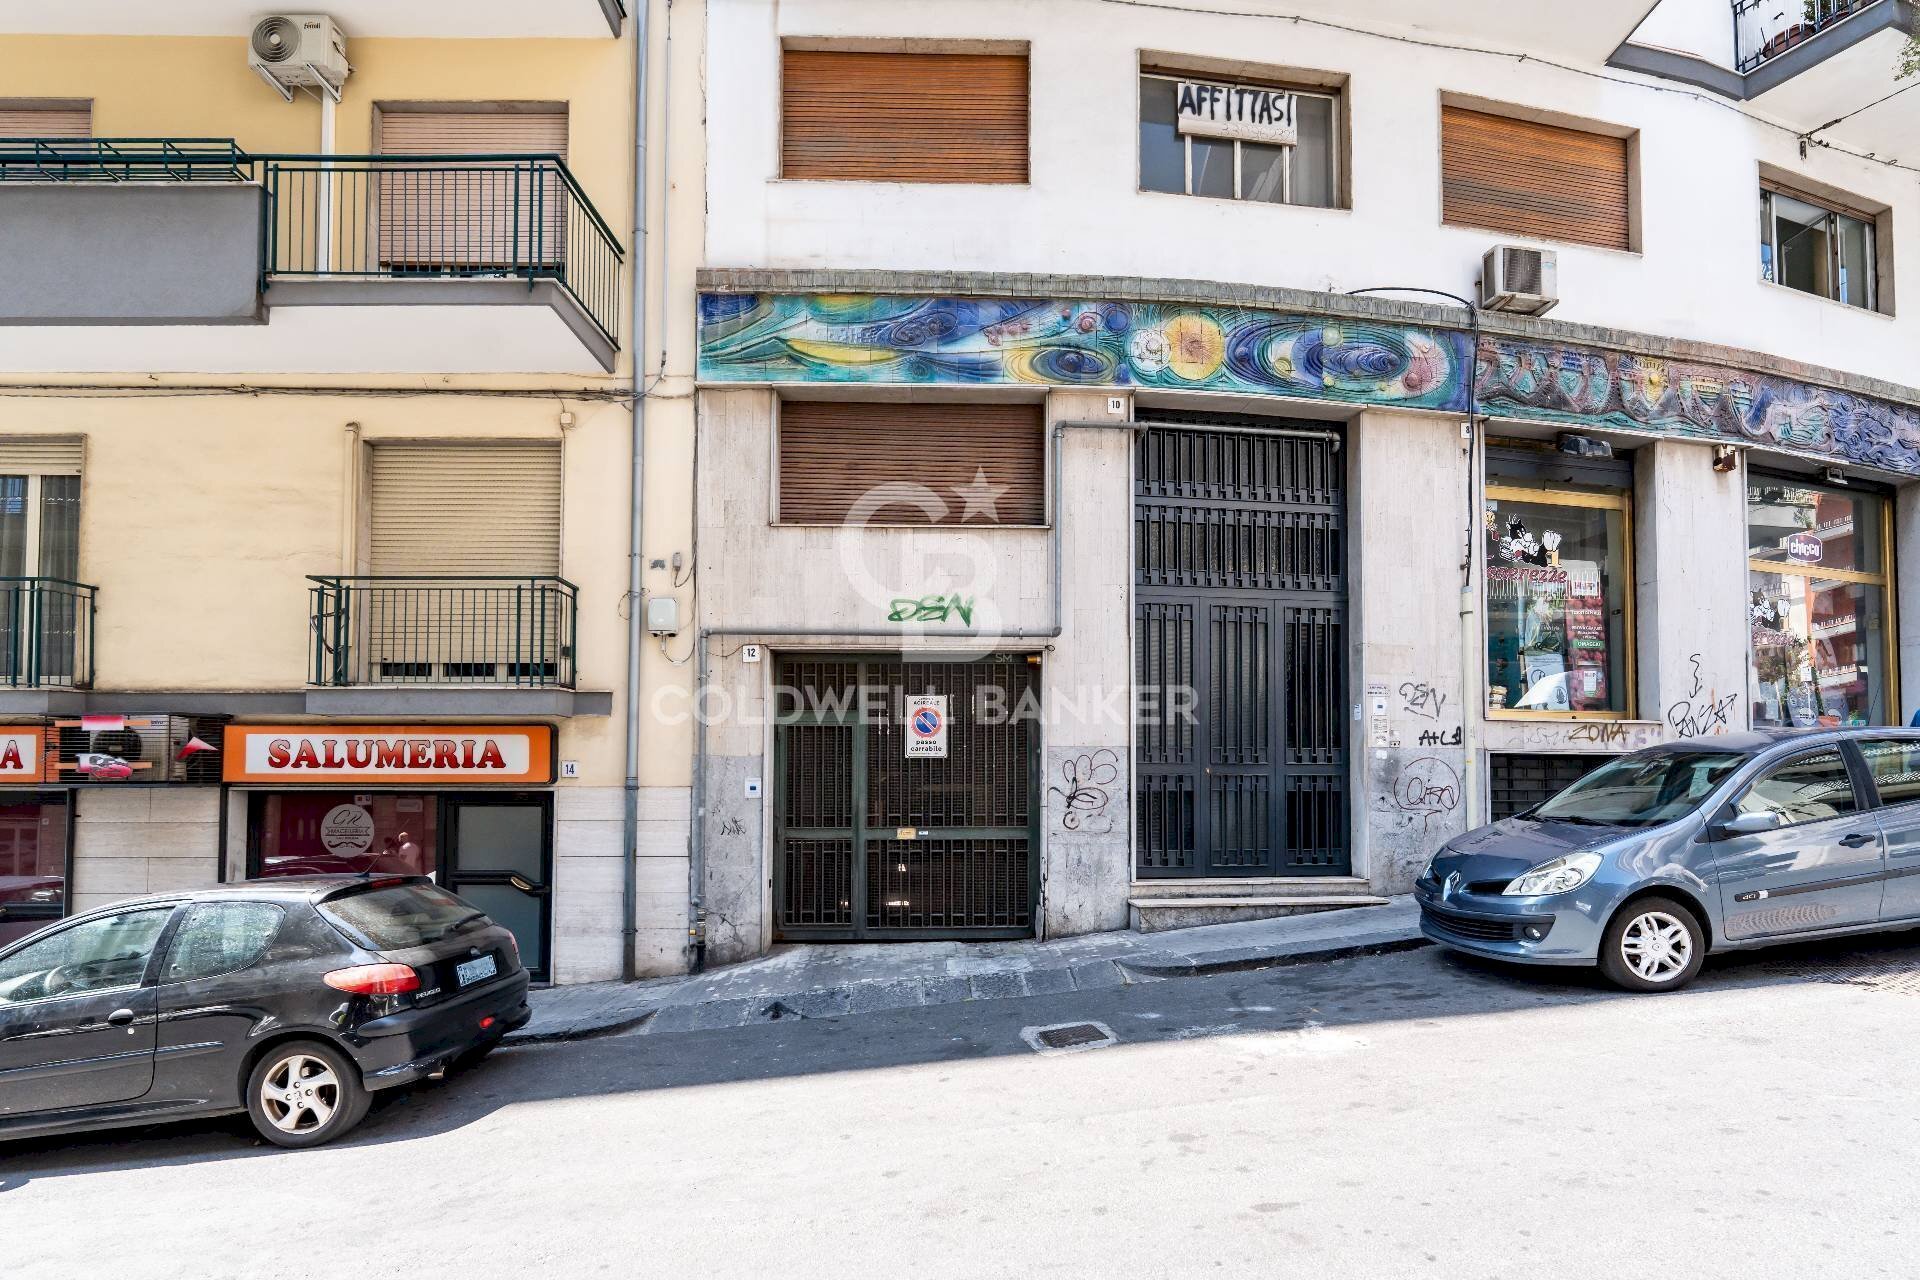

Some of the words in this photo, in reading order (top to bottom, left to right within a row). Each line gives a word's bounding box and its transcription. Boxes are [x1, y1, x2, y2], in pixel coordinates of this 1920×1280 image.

[1178, 85, 1293, 127] AFFITTASI
[1111, 400, 1121, 409] 10
[1790, 539, 1820, 556] chicco
[746, 648, 756, 657] 12
[1568, 723, 1629, 744] ZONA
[0, 739, 24, 769] A
[267, 738, 507, 769] SALUMERIA
[565, 764, 575, 775] 14
